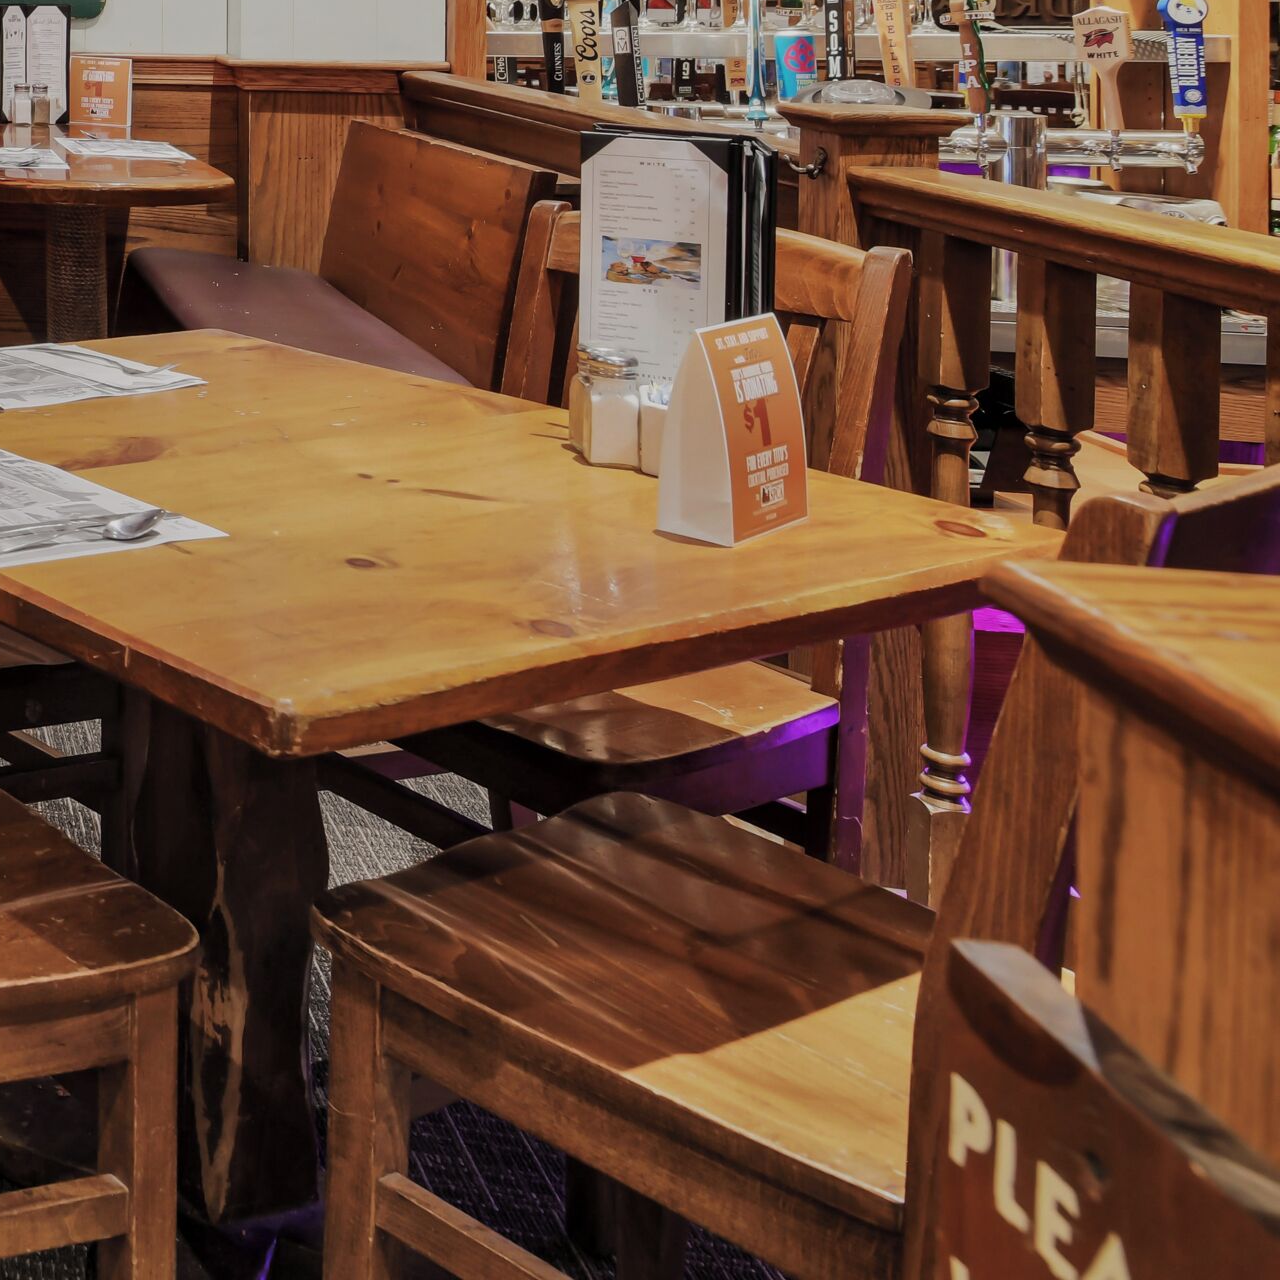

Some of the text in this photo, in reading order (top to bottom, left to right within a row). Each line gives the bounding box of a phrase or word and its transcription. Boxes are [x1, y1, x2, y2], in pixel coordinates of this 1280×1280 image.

[575, 7, 599, 63] Coors
[1076, 14, 1123, 26] ALLAGASH
[553, 41, 563, 82] GUINNESS
[884, 12, 902, 87] HELLES
[962, 43, 982, 89] IPA
[1087, 50, 1120, 60] WHITE
[1175, 36, 1199, 87] BLUEBERRY
[743, 397, 772, 448] $1
